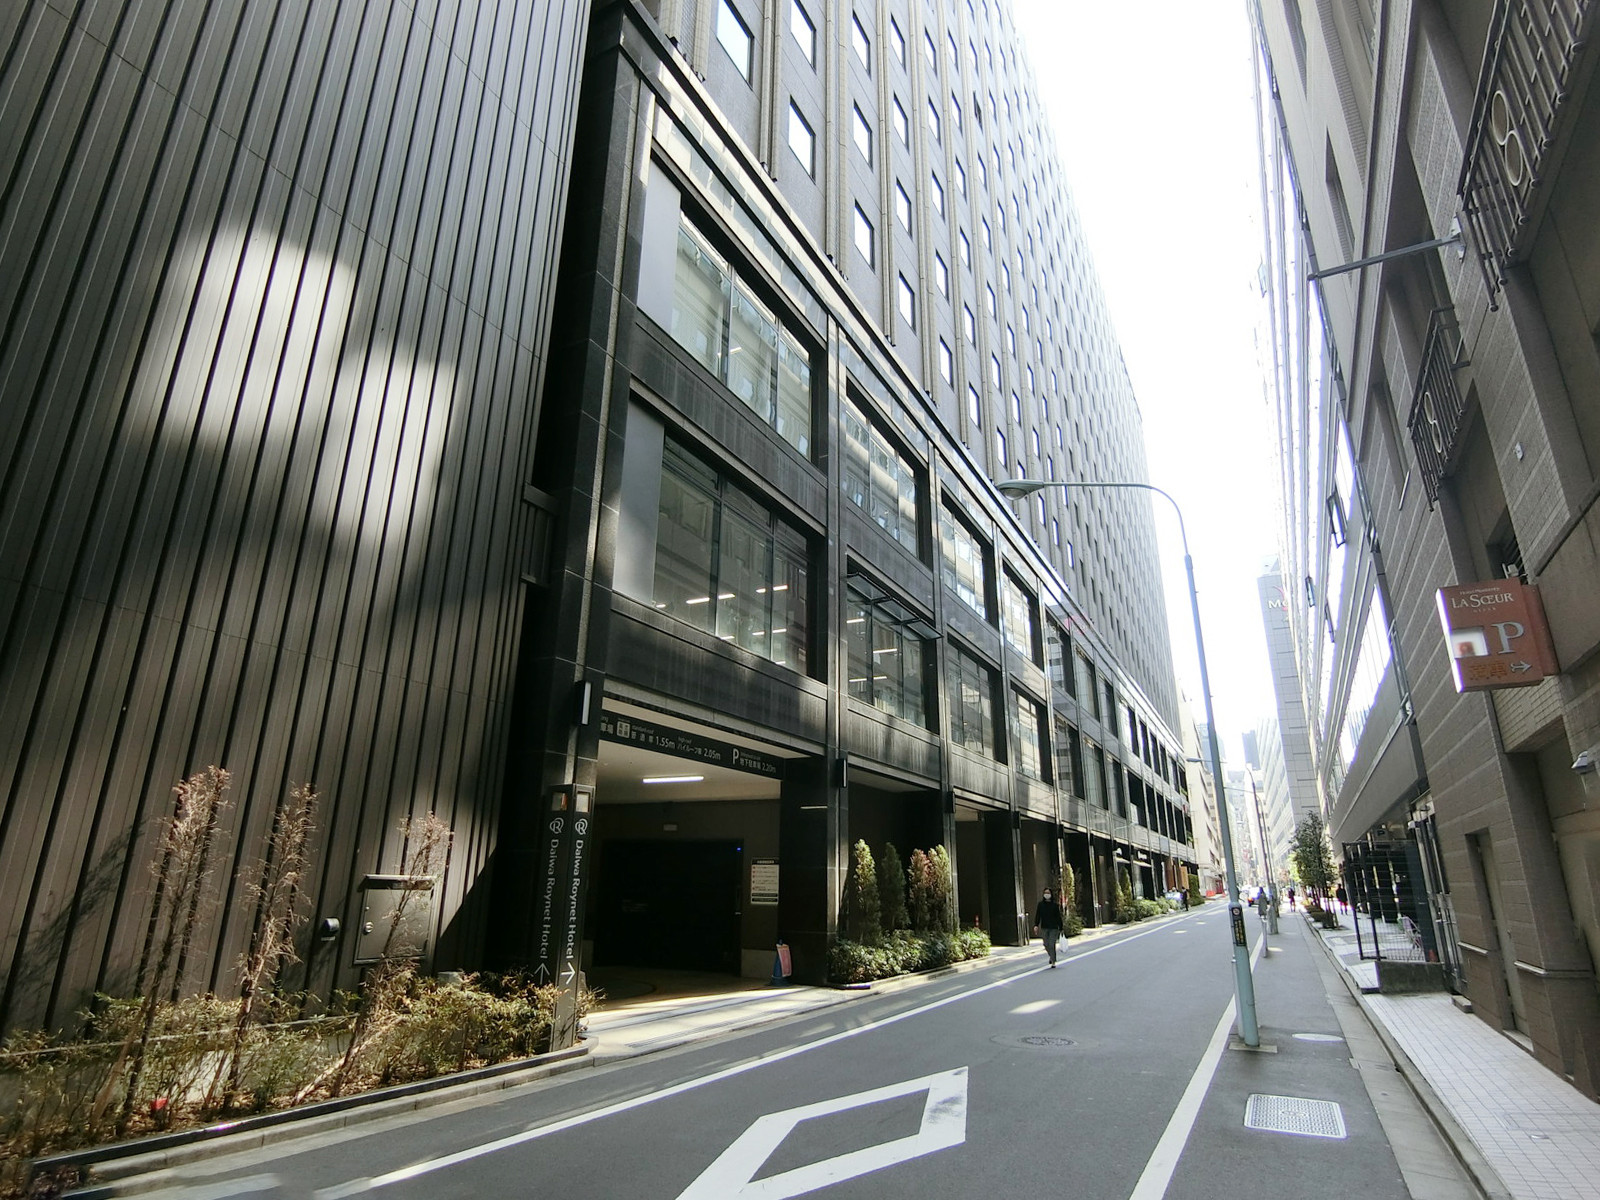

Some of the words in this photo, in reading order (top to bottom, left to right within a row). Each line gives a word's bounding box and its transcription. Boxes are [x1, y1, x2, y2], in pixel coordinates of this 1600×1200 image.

[1451, 597, 1469, 609] LA
[1491, 620, 1526, 655] P
[655, 736, 676, 749] 1.55m
[704, 748, 722, 760] 2.05m
[732, 748, 740, 765] P
[547, 839, 559, 875] Daiwa
[573, 839, 584, 876] Daiwa
[543, 877, 556, 921] Roynet
[569, 878, 580, 922] Roynet
[540, 924, 551, 959] Hotel
[565, 924, 577, 959] Hotel
